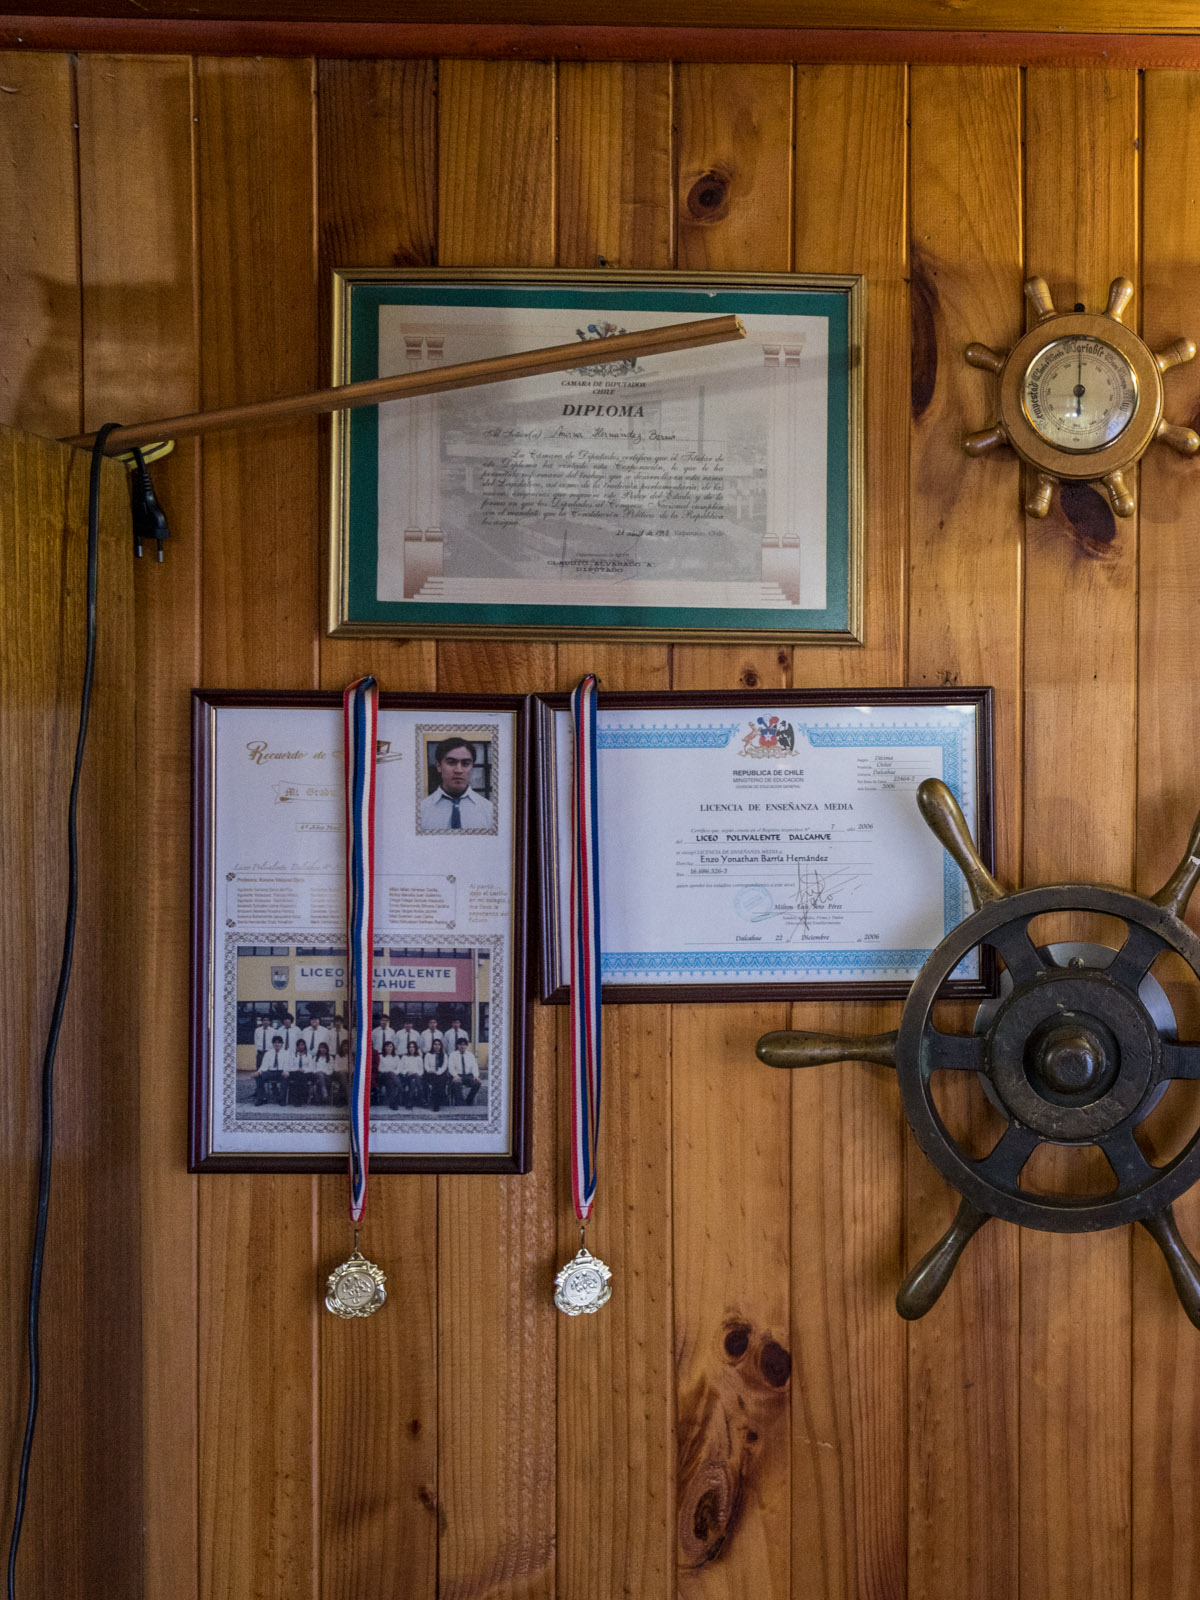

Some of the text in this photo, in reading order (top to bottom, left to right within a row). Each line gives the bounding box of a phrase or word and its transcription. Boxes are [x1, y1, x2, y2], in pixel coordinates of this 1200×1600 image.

[562, 405, 644, 417] DIPLOMA
[246, 741, 326, 765] Recuerdo de
[766, 802, 818, 811] ENSEÑANZA
[721, 856, 758, 864] Yonathan
[301, 968, 451, 978] LICEO LIVALENTE
